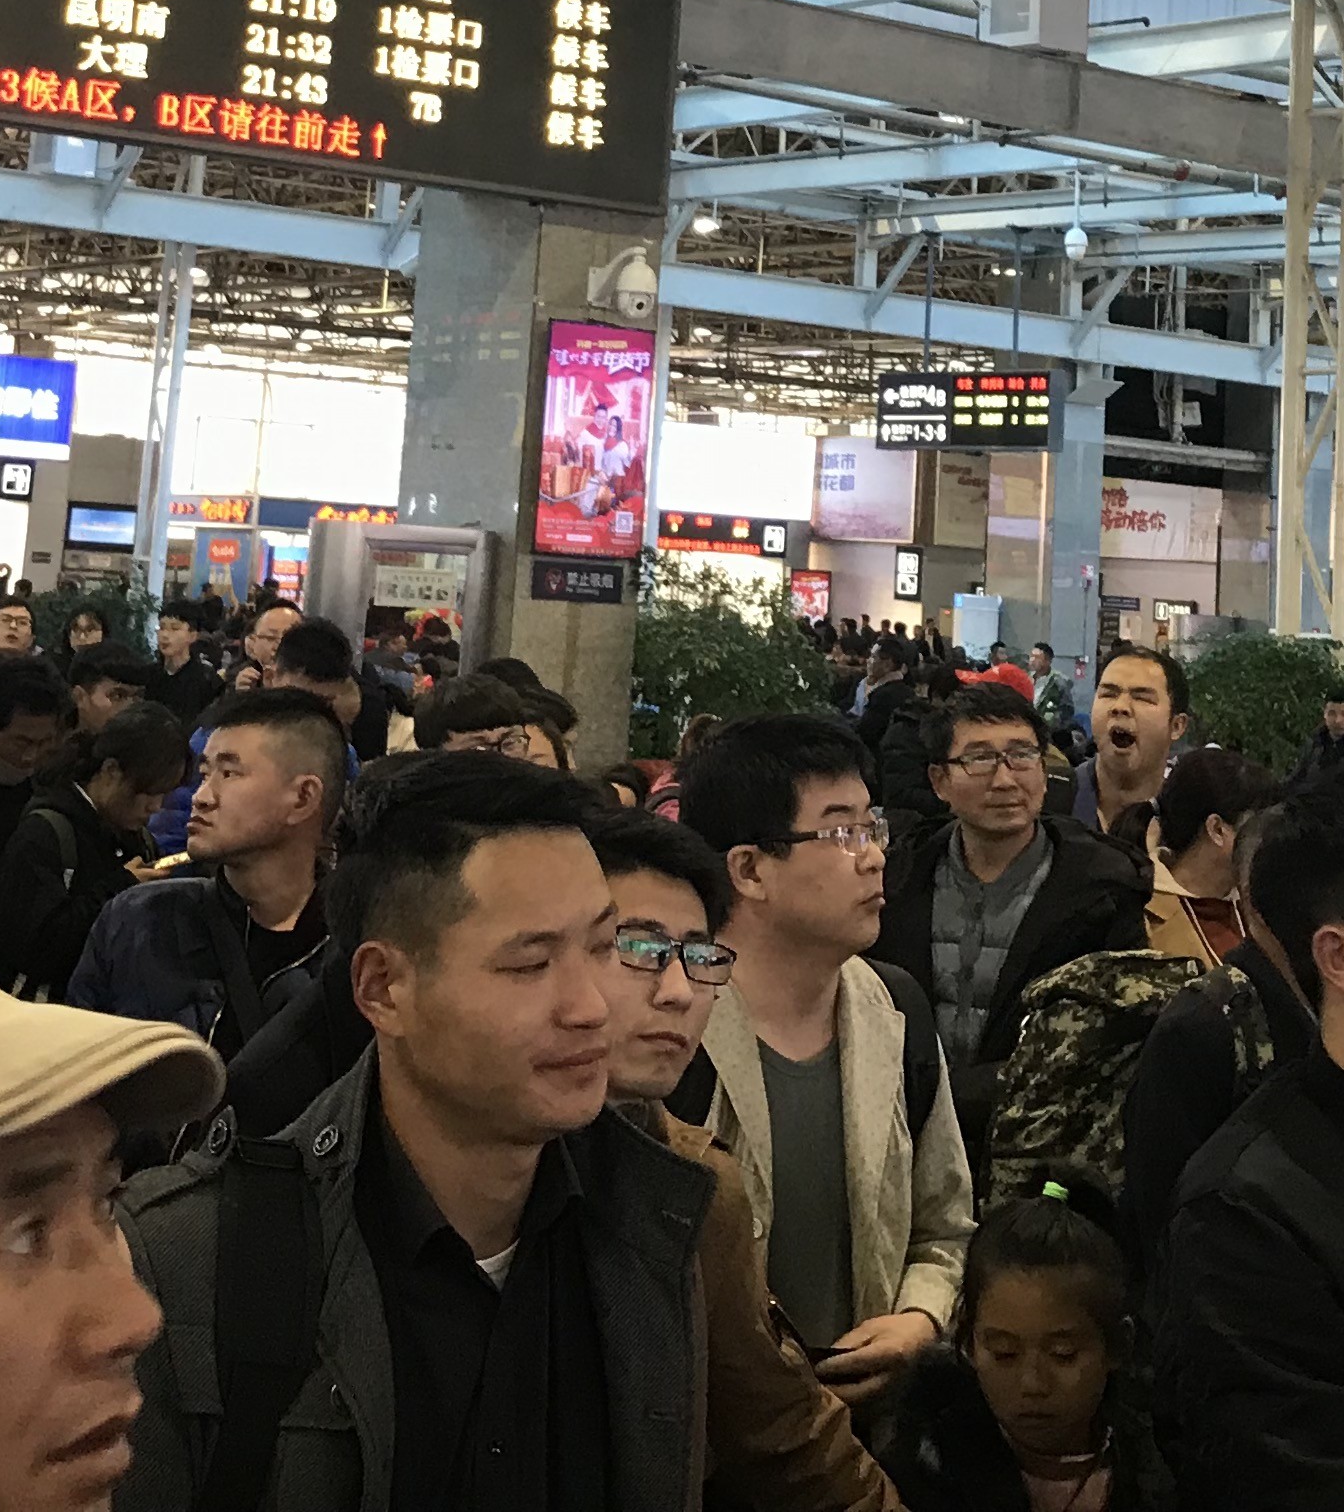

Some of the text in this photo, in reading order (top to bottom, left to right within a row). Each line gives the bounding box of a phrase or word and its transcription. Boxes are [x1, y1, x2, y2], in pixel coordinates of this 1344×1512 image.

[245, 23, 333, 65] 21:32
[374, 44, 481, 90] 1检票口
[549, 71, 608, 111] 候车
[377, 4, 484, 50] 1检票口
[551, 33, 610, 73] 候车
[77, 34, 149, 79] 大理
[241, 64, 329, 105] 21:43
[408, 91, 443, 123] 7B
[546, 110, 605, 150] 候车
